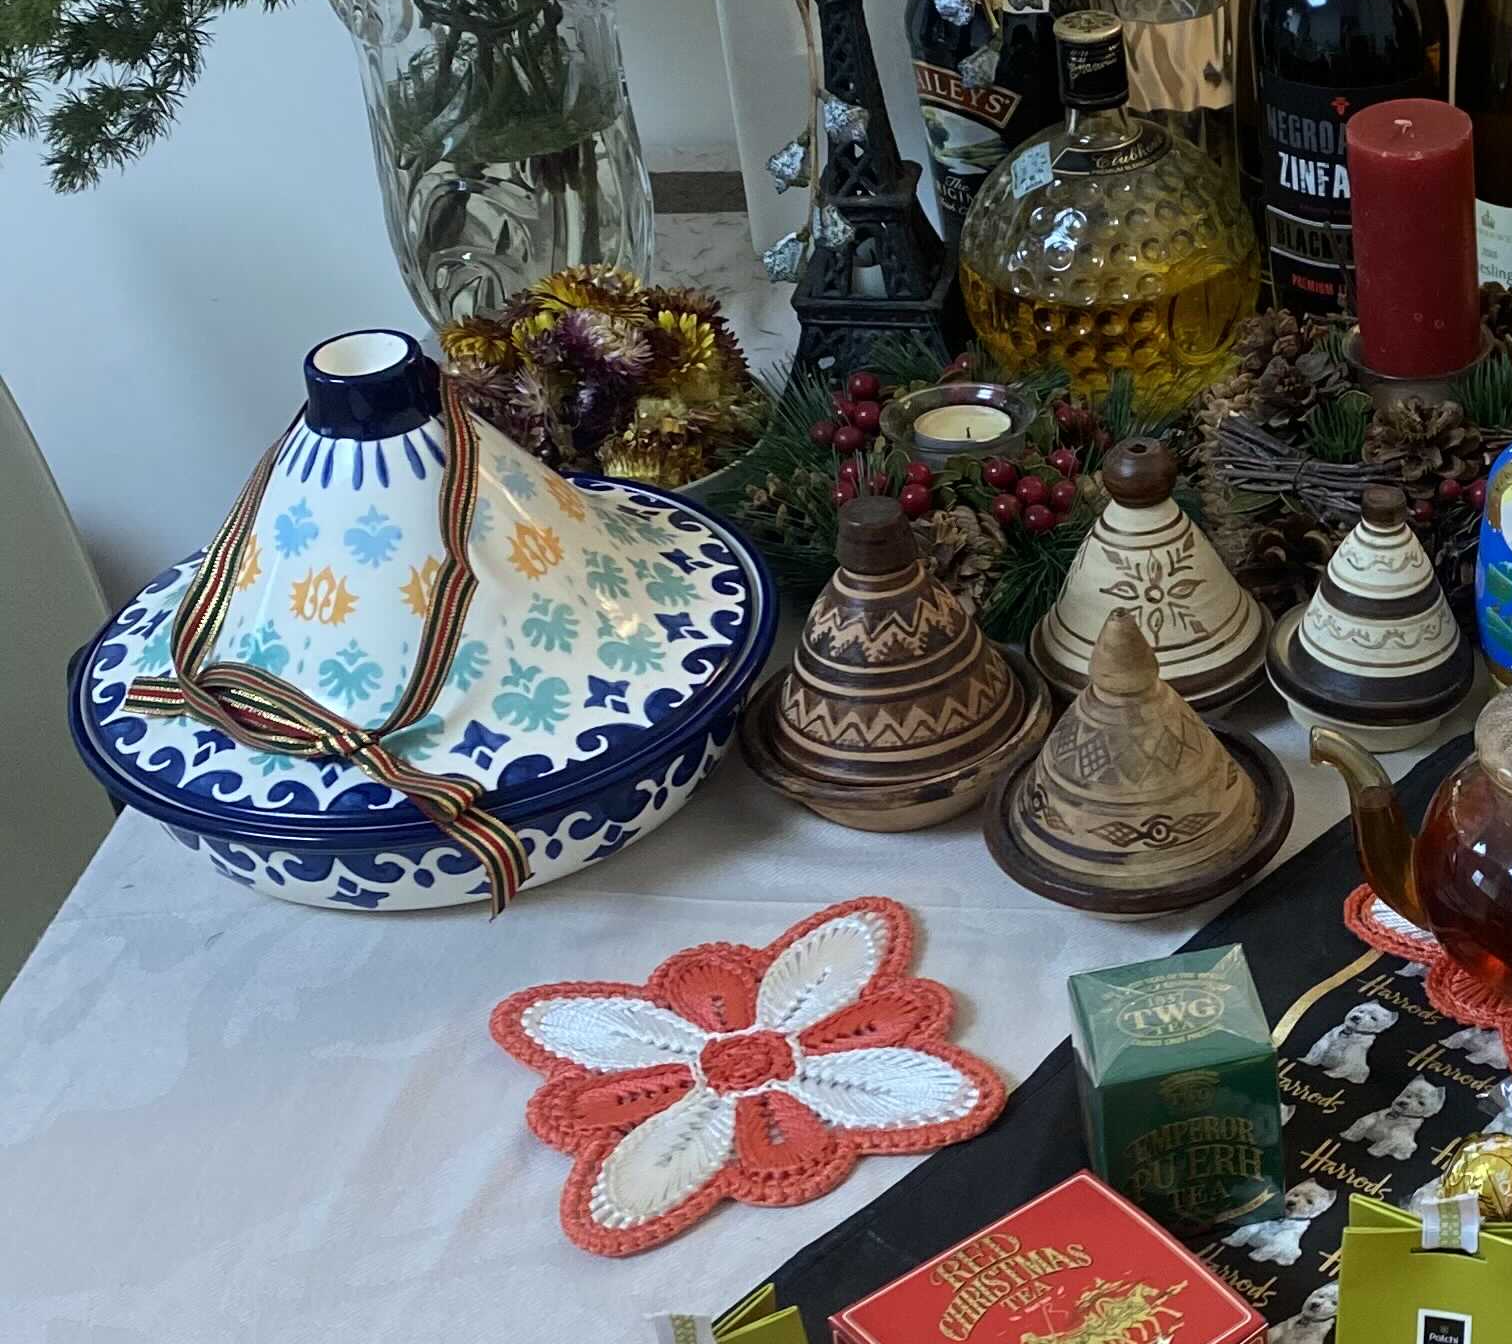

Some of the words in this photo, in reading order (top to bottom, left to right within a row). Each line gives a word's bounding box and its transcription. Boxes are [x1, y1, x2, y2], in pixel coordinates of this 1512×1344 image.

[917, 73, 1003, 115] AILEYS
[1266, 103, 1348, 154] NEGROA
[1278, 151, 1351, 199] ZINFA
[1123, 998, 1218, 1030] TWG
[1357, 974, 1442, 1026] Harrods
[1407, 1044, 1498, 1099] Harrods
[1301, 1138, 1394, 1203] Harrods
[928, 1232, 1023, 1294] RED
[937, 1242, 1094, 1343] CHRISTMAS
[1002, 1279, 1056, 1313] TEA
